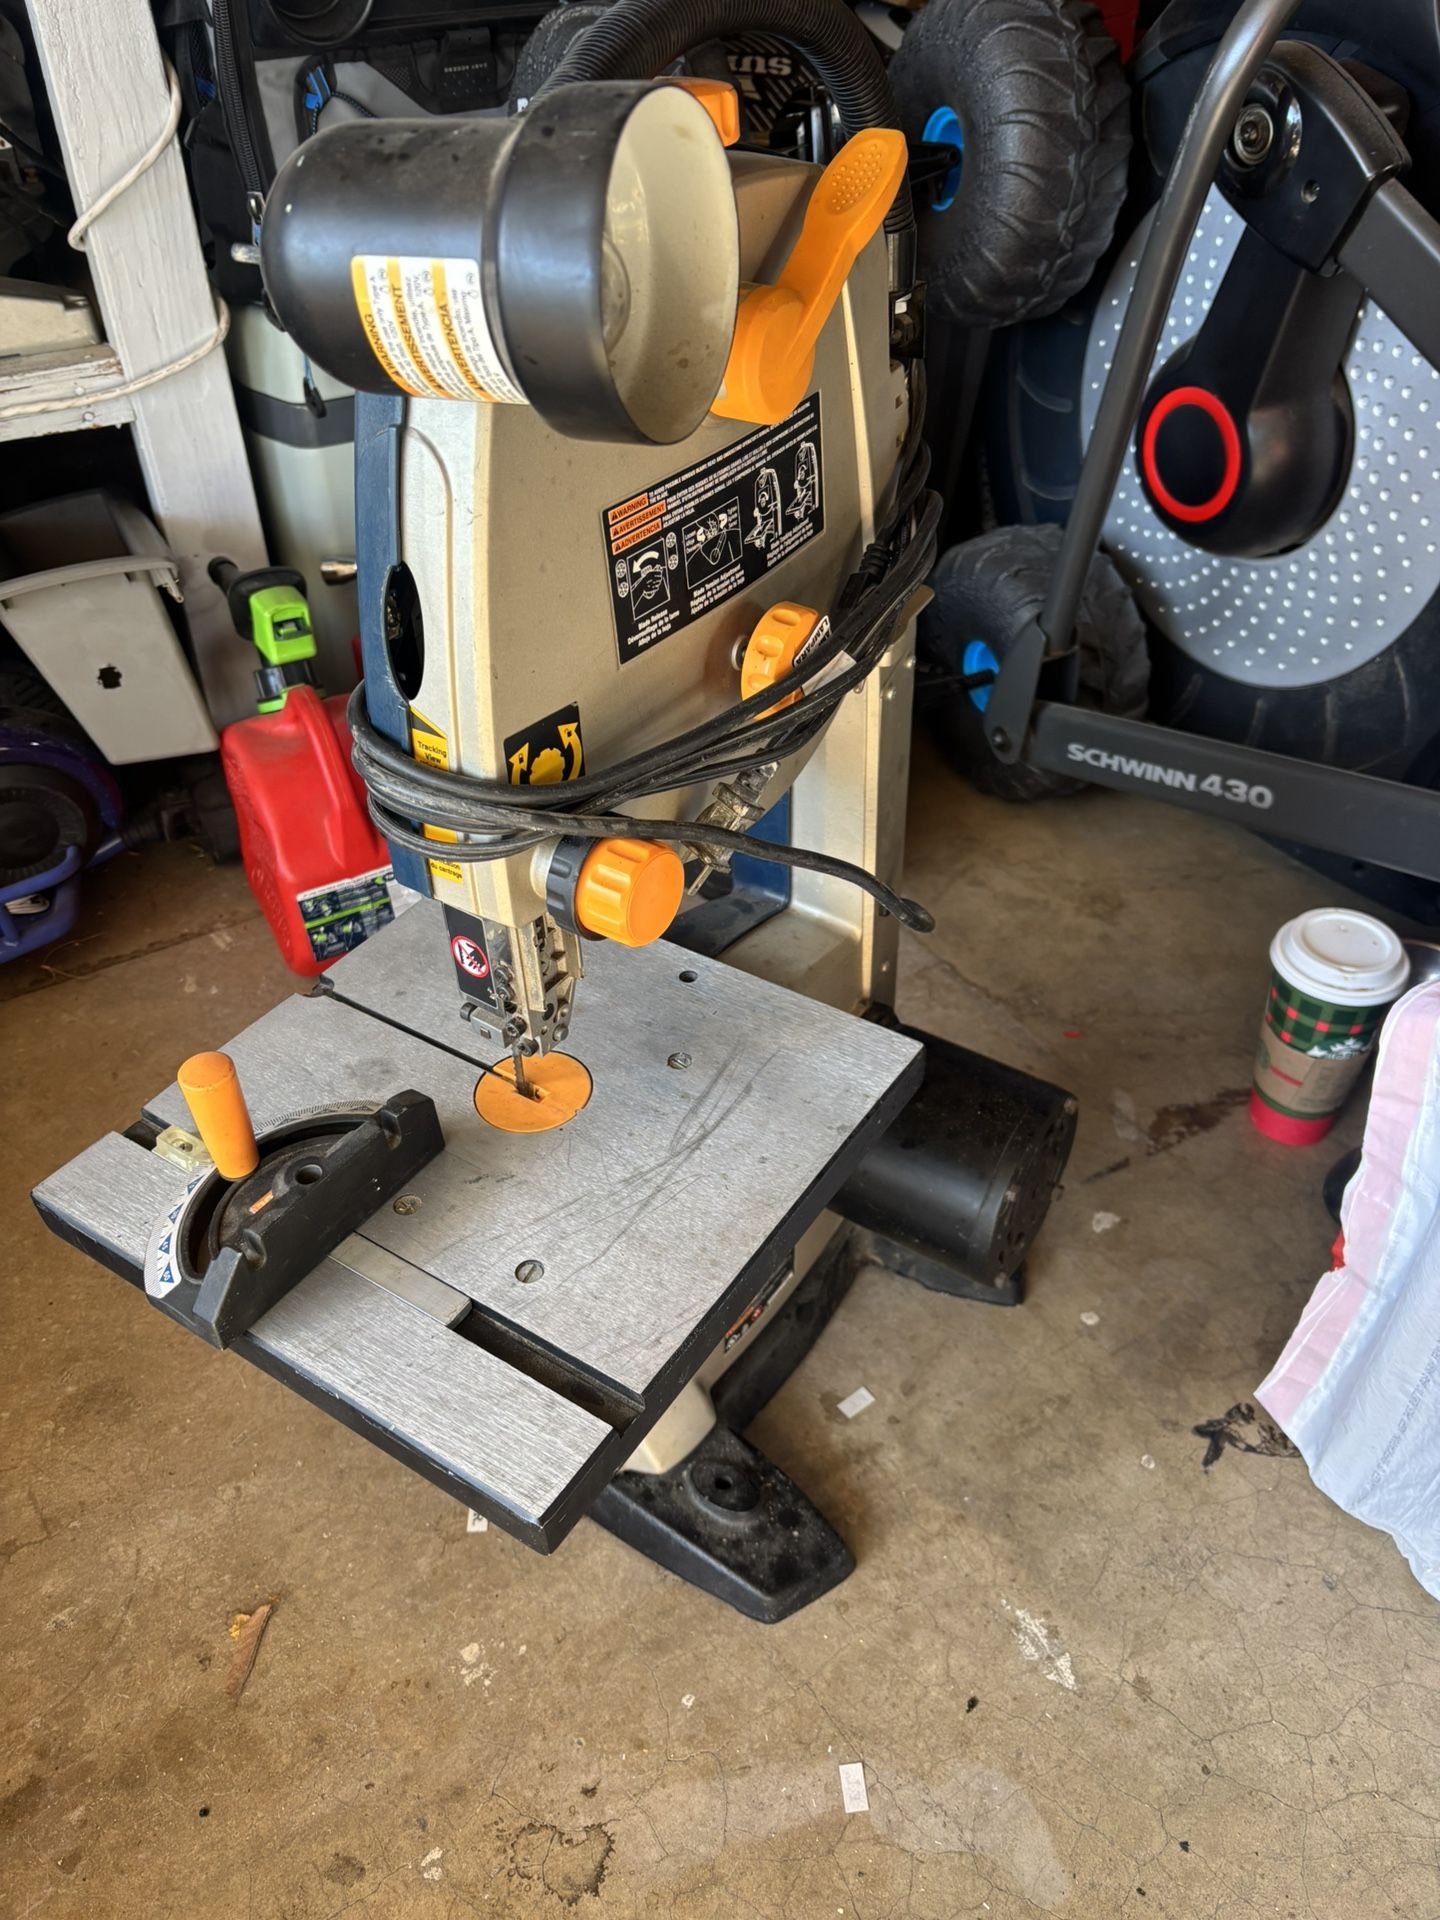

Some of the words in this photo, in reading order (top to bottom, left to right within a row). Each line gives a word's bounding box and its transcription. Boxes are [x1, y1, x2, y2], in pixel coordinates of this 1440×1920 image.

[364, 313, 397, 369] WARNING
[392, 284, 436, 385] AVERTISSEMENT
[439, 304, 478, 387] ADVERTENCIA
[616, 498, 646, 519] WARNING
[619, 504, 665, 532] AVERTISSEMENT
[621, 522, 660, 545] ADVERTENCIA
[693, 587, 704, 597] Blade
[638, 619, 650, 630] Blade
[651, 609, 668, 622] Release
[417, 741, 447, 758] Tracking
[425, 753, 441, 764] View
[1067, 743, 1198, 792] SCHWINN
[1200, 774, 1273, 809] 430
[438, 864, 463, 880] centrage
